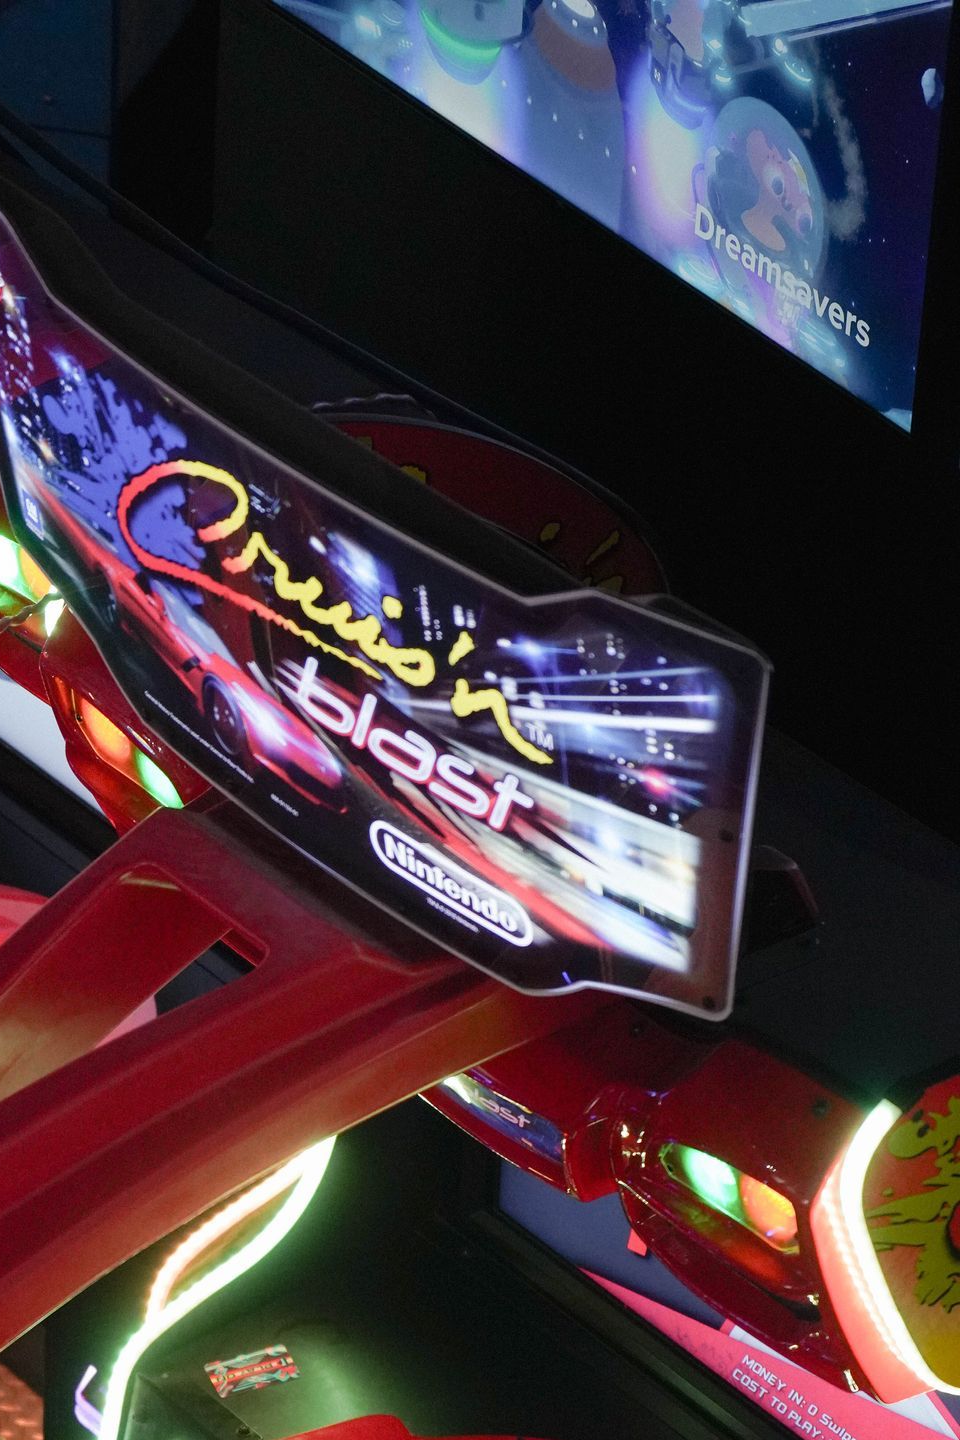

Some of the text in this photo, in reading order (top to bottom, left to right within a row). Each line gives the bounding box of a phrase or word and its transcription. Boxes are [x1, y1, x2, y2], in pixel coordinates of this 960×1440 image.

[694, 203, 870, 347] Dreamsavers
[276, 656, 533, 831] blast
[383, 833, 517, 932] Nintendo
[464, 1082, 530, 1128] last
[732, 1368, 768, 1398] COST
[770, 1395, 788, 1415] TO
[742, 1354, 786, 1391] MONEY
[788, 1389, 806, 1408] IN:
